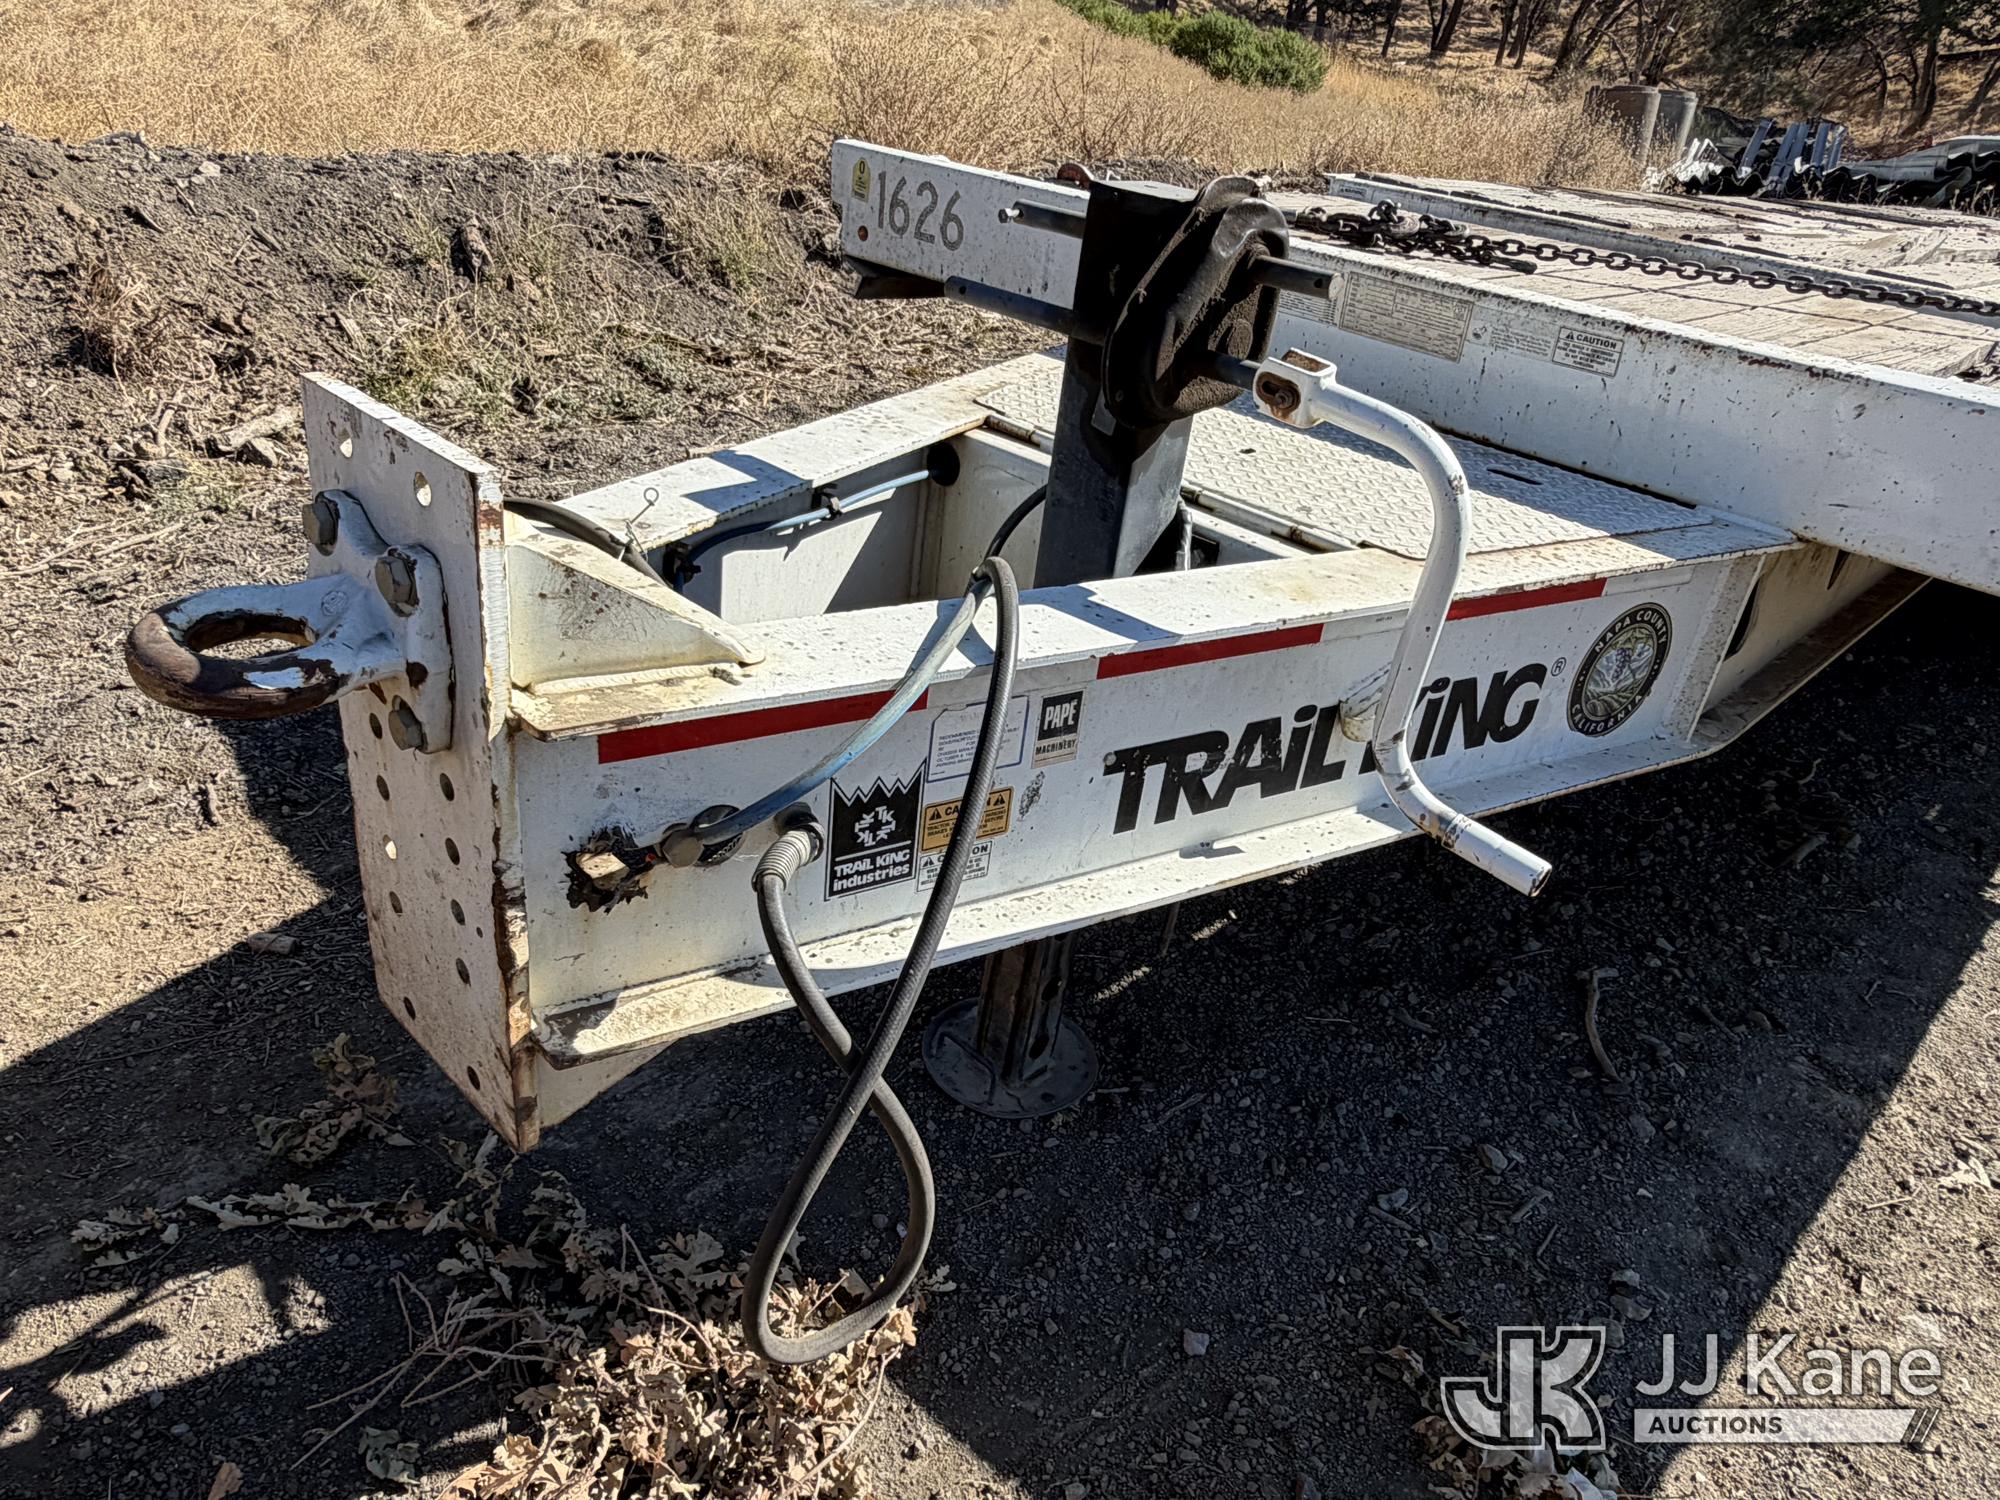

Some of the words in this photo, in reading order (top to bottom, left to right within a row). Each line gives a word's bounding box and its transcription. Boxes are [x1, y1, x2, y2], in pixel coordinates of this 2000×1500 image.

[878, 171, 964, 251] 1626
[1576, 334, 1617, 350] CAUTION
[1595, 616, 1631, 653] NAPA
[1636, 610, 1668, 644] COUNTY
[1036, 739, 1077, 755] MACHINERY
[833, 864, 910, 892] industries
